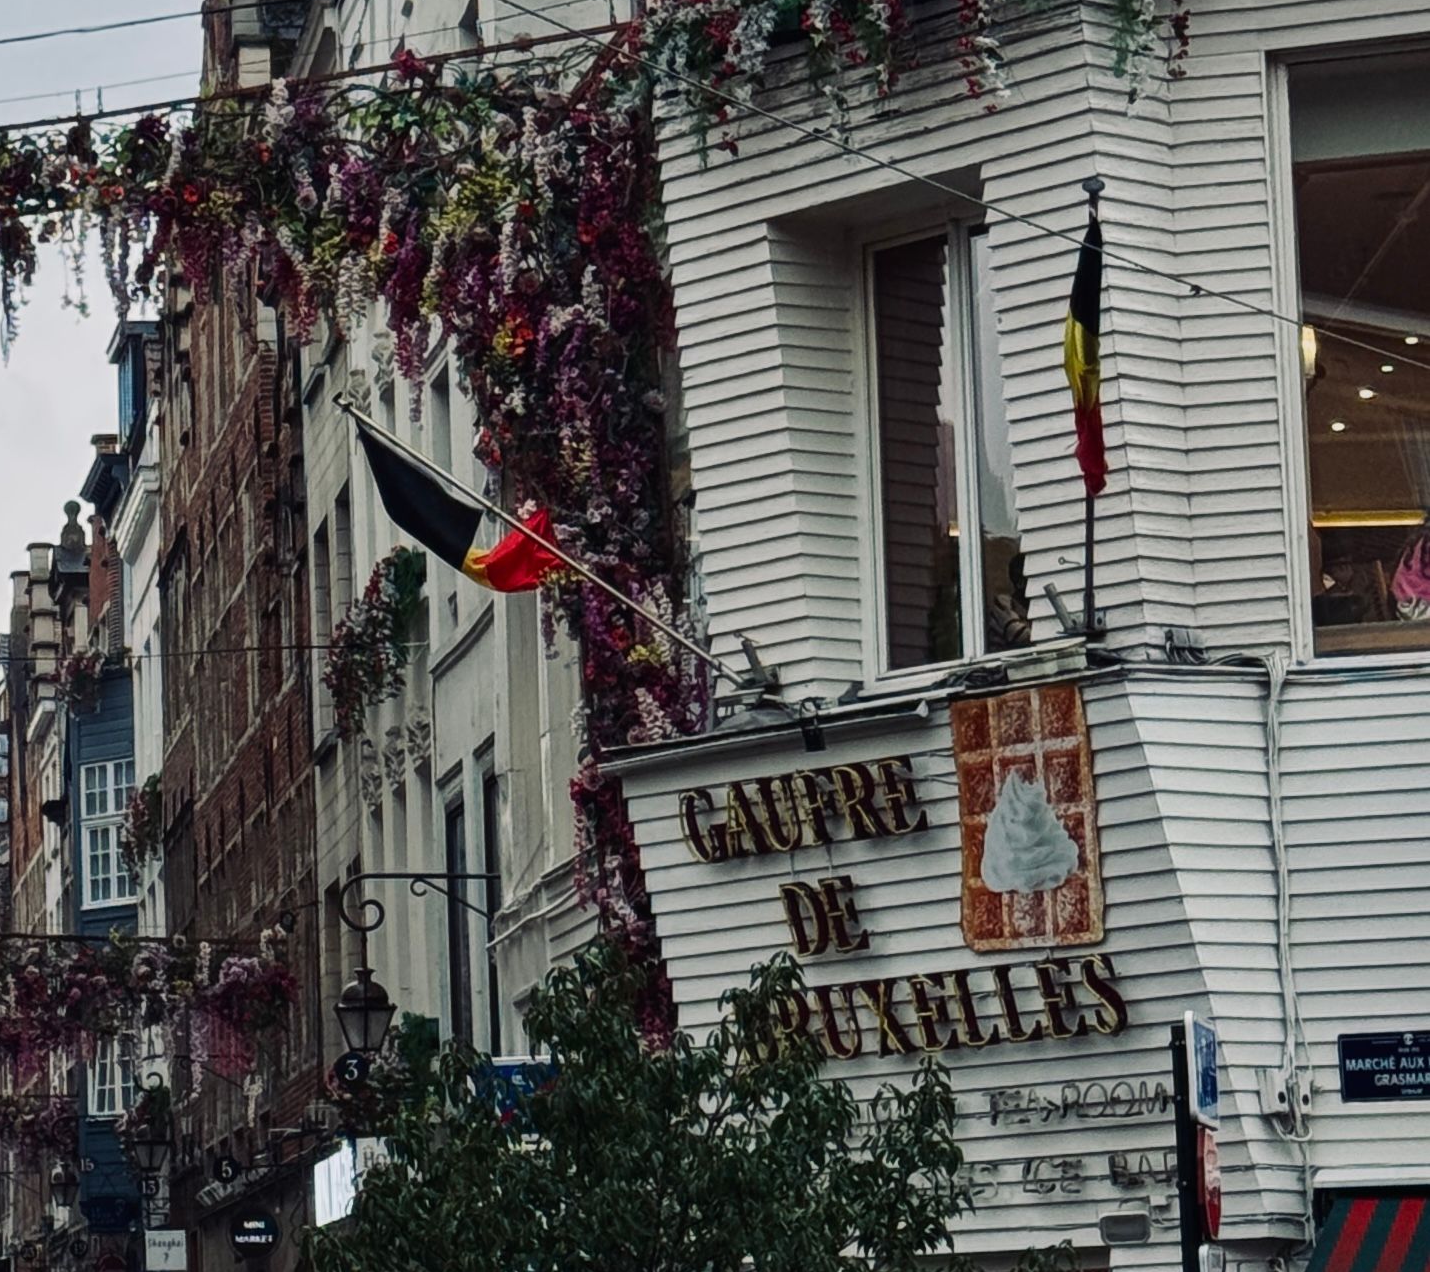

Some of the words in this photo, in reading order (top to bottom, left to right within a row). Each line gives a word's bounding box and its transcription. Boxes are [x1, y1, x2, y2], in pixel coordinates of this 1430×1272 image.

[678, 755, 928, 863] GAUFRE
[778, 874, 869, 958] DE
[737, 953, 1129, 1063] RUXELLES
[344, 1059, 359, 1081] 3
[1345, 1055, 1396, 1071] MARCHÉ
[1399, 1056, 1425, 1070] AUX
[222, 1160, 233, 1178] 5
[234, 1234, 273, 1244] MARKET
